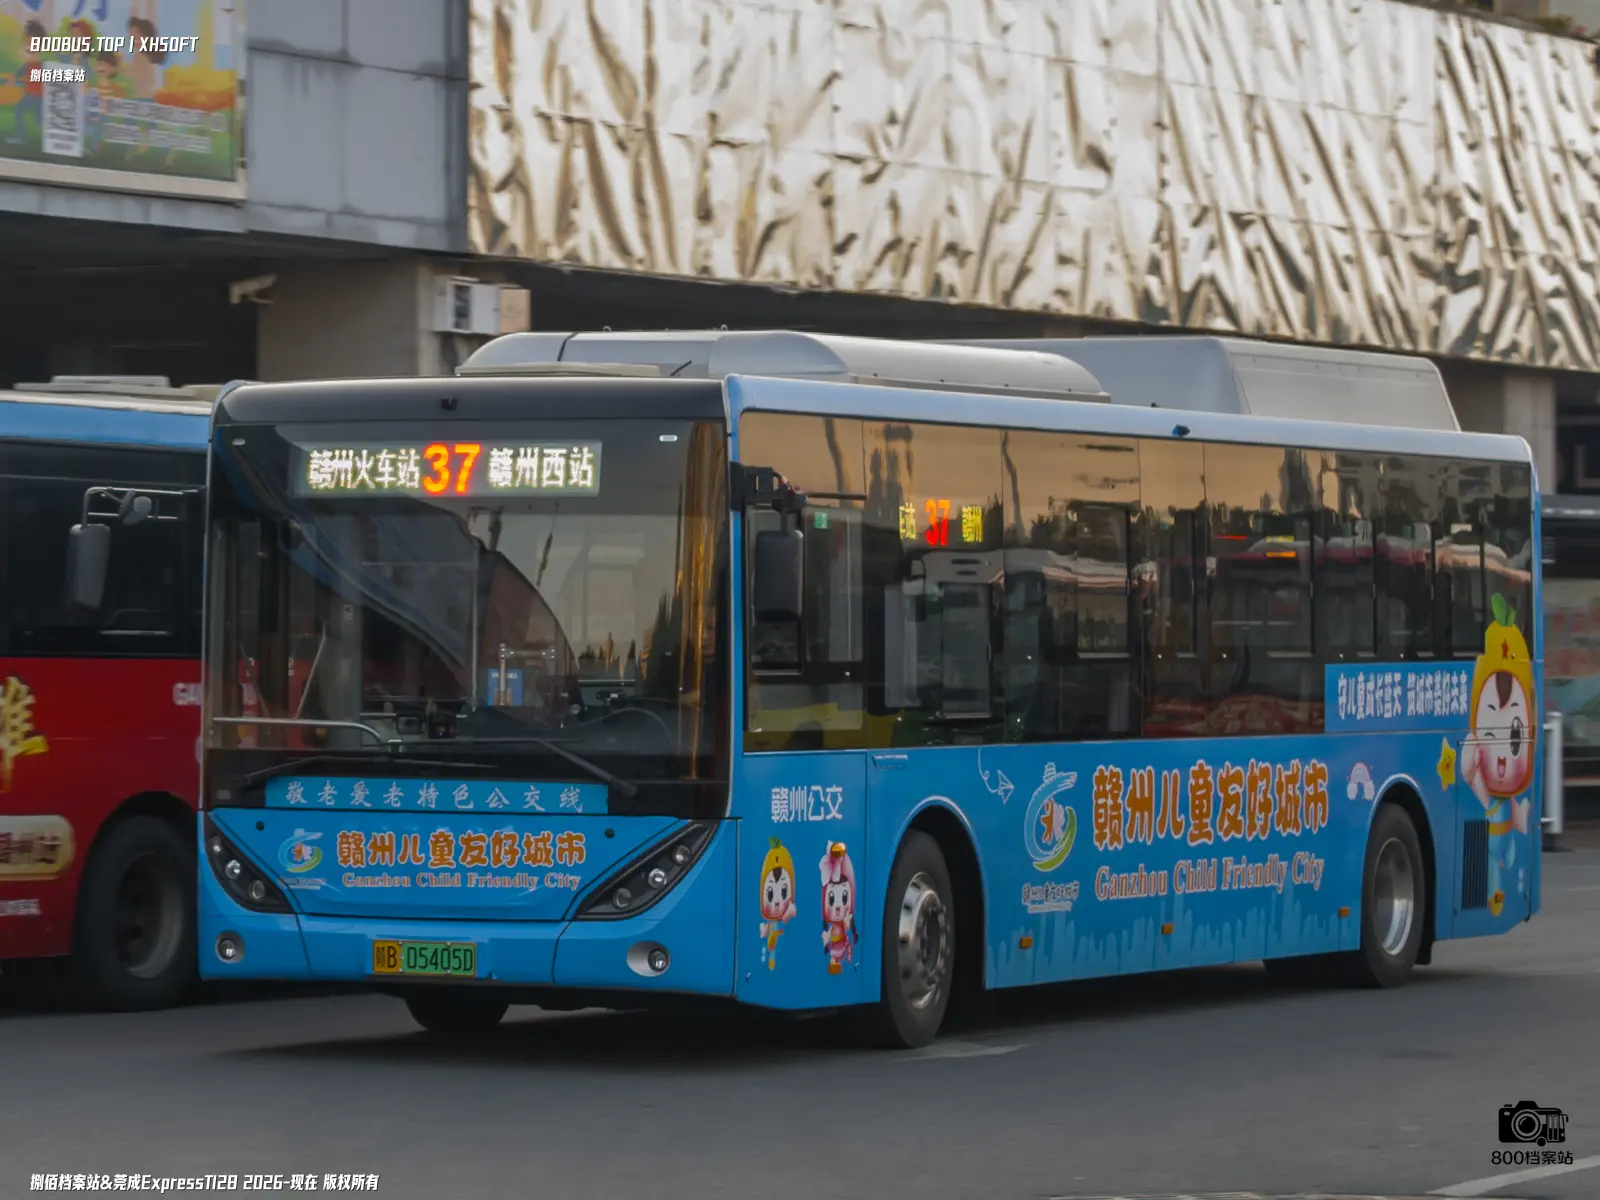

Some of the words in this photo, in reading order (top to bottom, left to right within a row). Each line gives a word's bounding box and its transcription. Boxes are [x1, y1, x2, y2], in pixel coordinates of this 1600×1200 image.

[307, 448, 420, 489] 赣州火车站
[422, 442, 480, 494] 37
[487, 446, 595, 488] 赣州西站
[924, 498, 950, 547] 37
[285, 780, 584, 813] 敬老爱老特色公交线
[770, 785, 844, 823] 赣州公交
[1093, 758, 1330, 852] 赣州儿童友好城市
[337, 830, 587, 869] 赣州儿童友好城市
[341, 872, 411, 888] Ganzhou
[416, 872, 462, 888] Child
[466, 872, 540, 892] Friendly
[544, 872, 582, 891] City
[1094, 864, 1168, 901] Ganzhou
[1173, 858, 1217, 894] Child
[1221, 853, 1288, 895] Friendly
[1292, 851, 1325, 891] City
